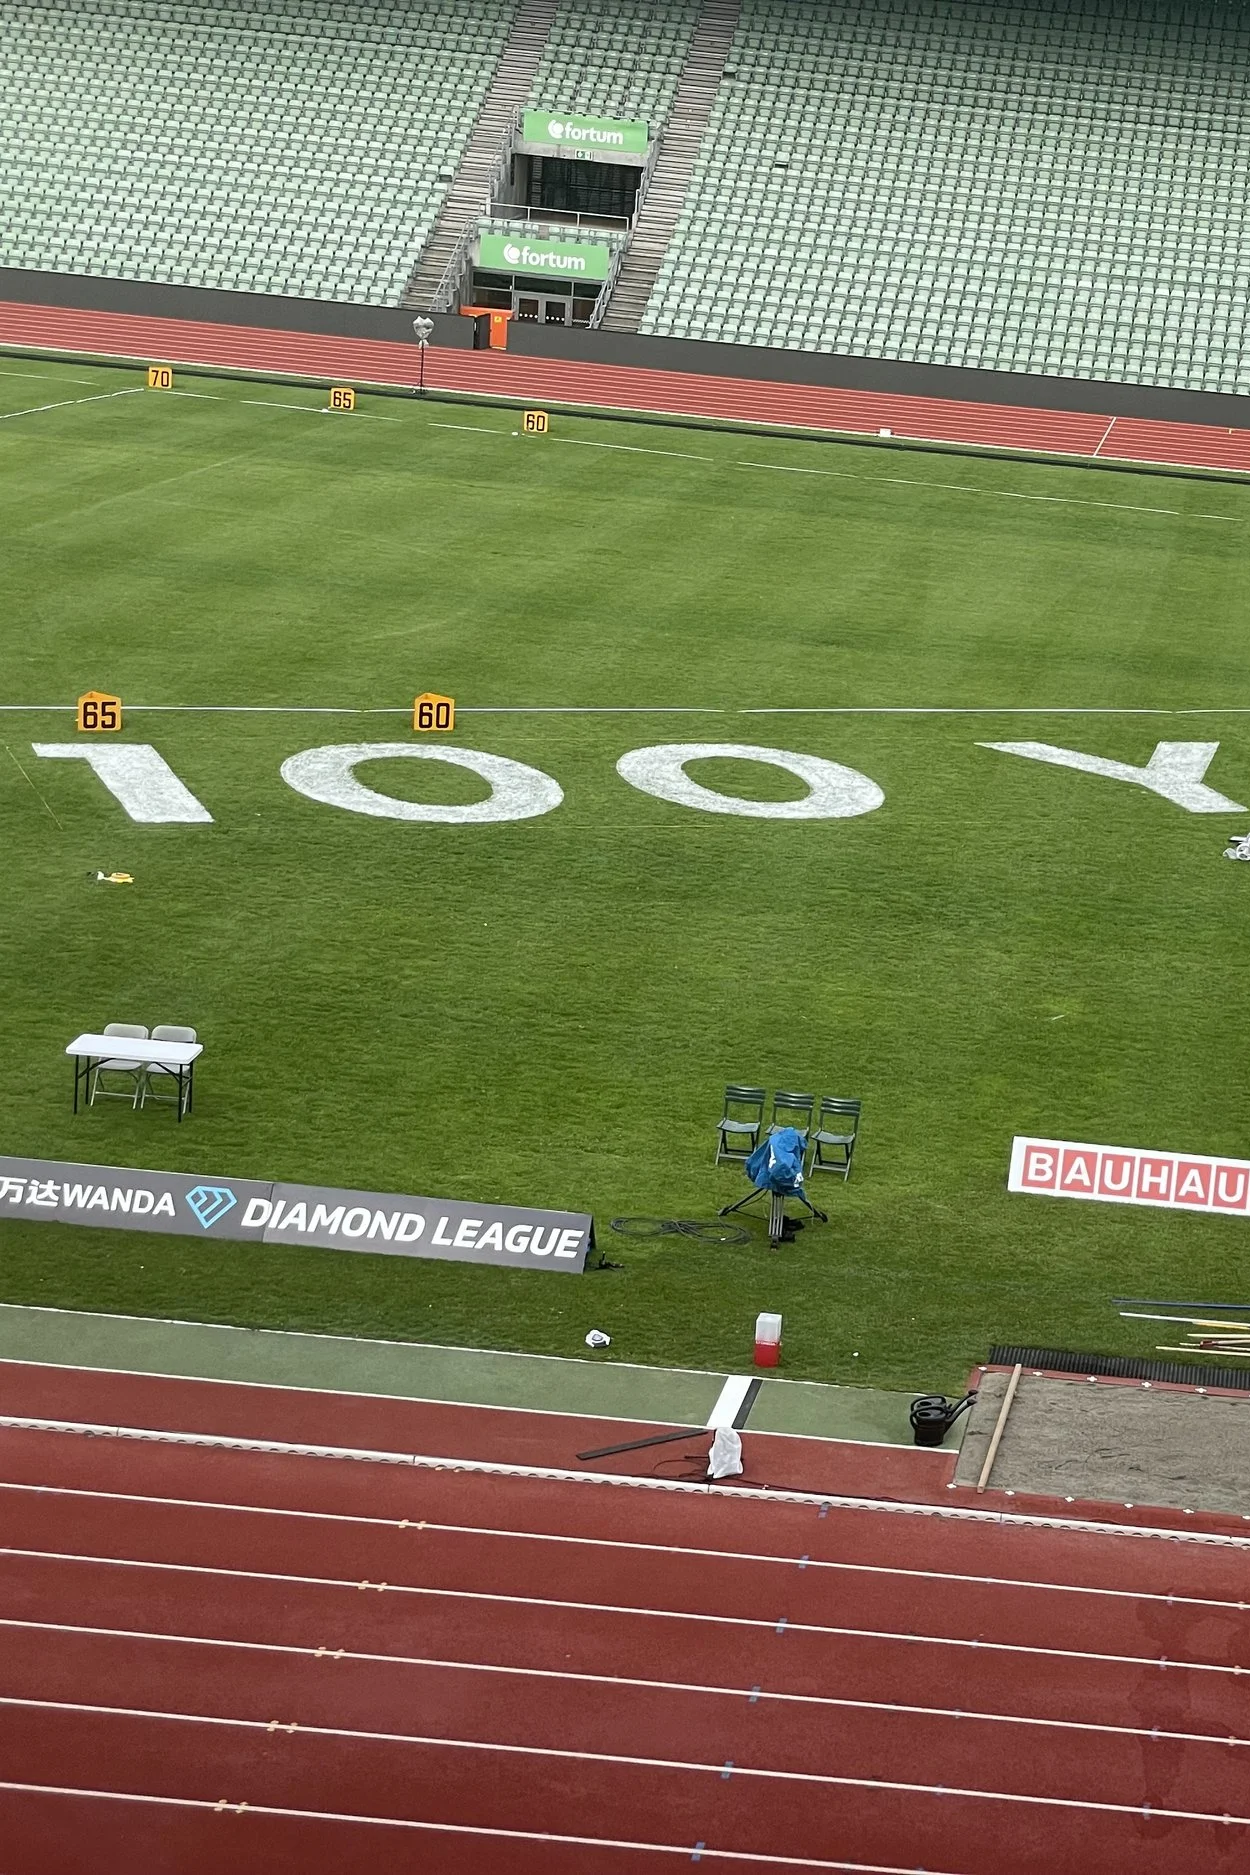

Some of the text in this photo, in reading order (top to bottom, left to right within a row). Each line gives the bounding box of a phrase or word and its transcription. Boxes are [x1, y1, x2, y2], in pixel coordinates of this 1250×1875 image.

[565, 121, 624, 145] fortum
[521, 245, 585, 271] fortum
[151, 369, 170, 387] 70
[333, 390, 352, 409] 65
[526, 413, 546, 432] 60
[83, 701, 117, 729] 65
[418, 702, 451, 729] 60
[31, 742, 886, 823] 100
[240, 1197, 426, 1243] DIAMOND
[431, 1216, 585, 1259] LEAGUE
